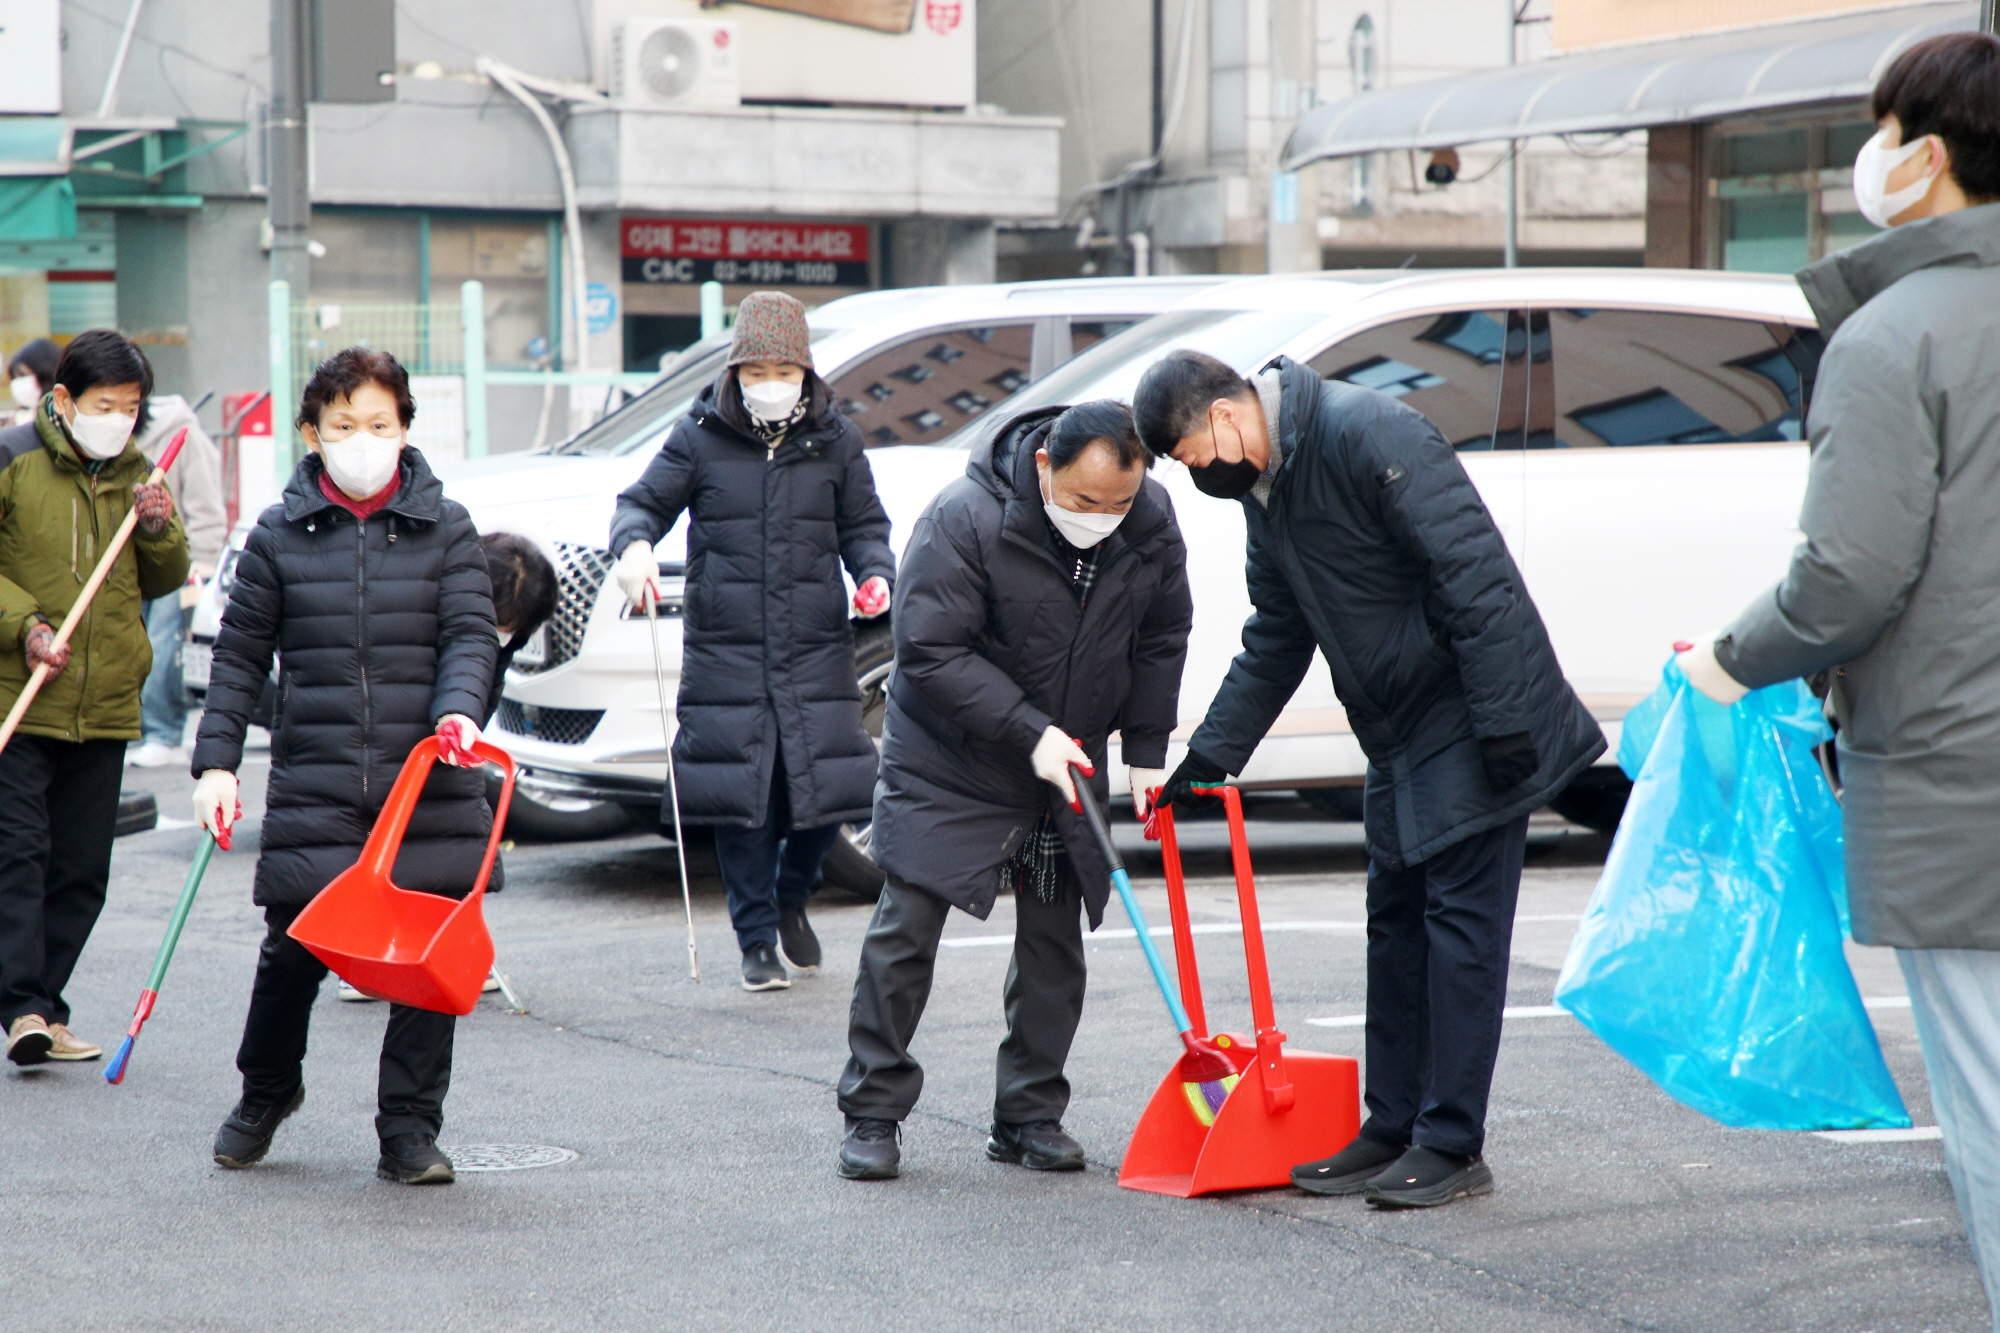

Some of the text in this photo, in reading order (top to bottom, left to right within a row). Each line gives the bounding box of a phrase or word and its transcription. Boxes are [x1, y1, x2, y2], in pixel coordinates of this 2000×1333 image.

[628, 226, 673, 253] 이제
[678, 227, 722, 254] 그만
[643, 258, 695, 281] C&C
